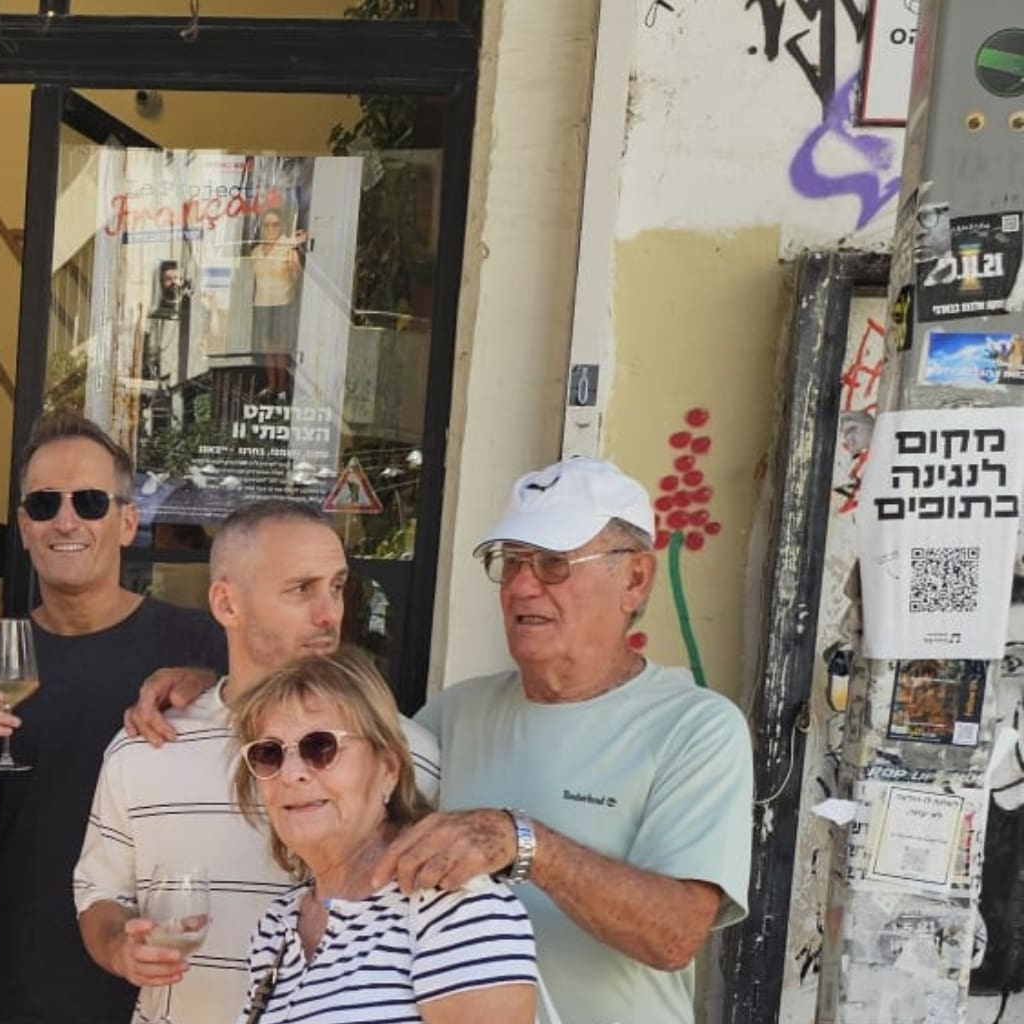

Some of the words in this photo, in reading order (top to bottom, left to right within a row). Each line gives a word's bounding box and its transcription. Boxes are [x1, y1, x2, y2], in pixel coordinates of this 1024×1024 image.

[894, 428, 1006, 460] מקום
[891, 458, 1007, 489] לנגינה
[873, 494, 1019, 520] בתופים
